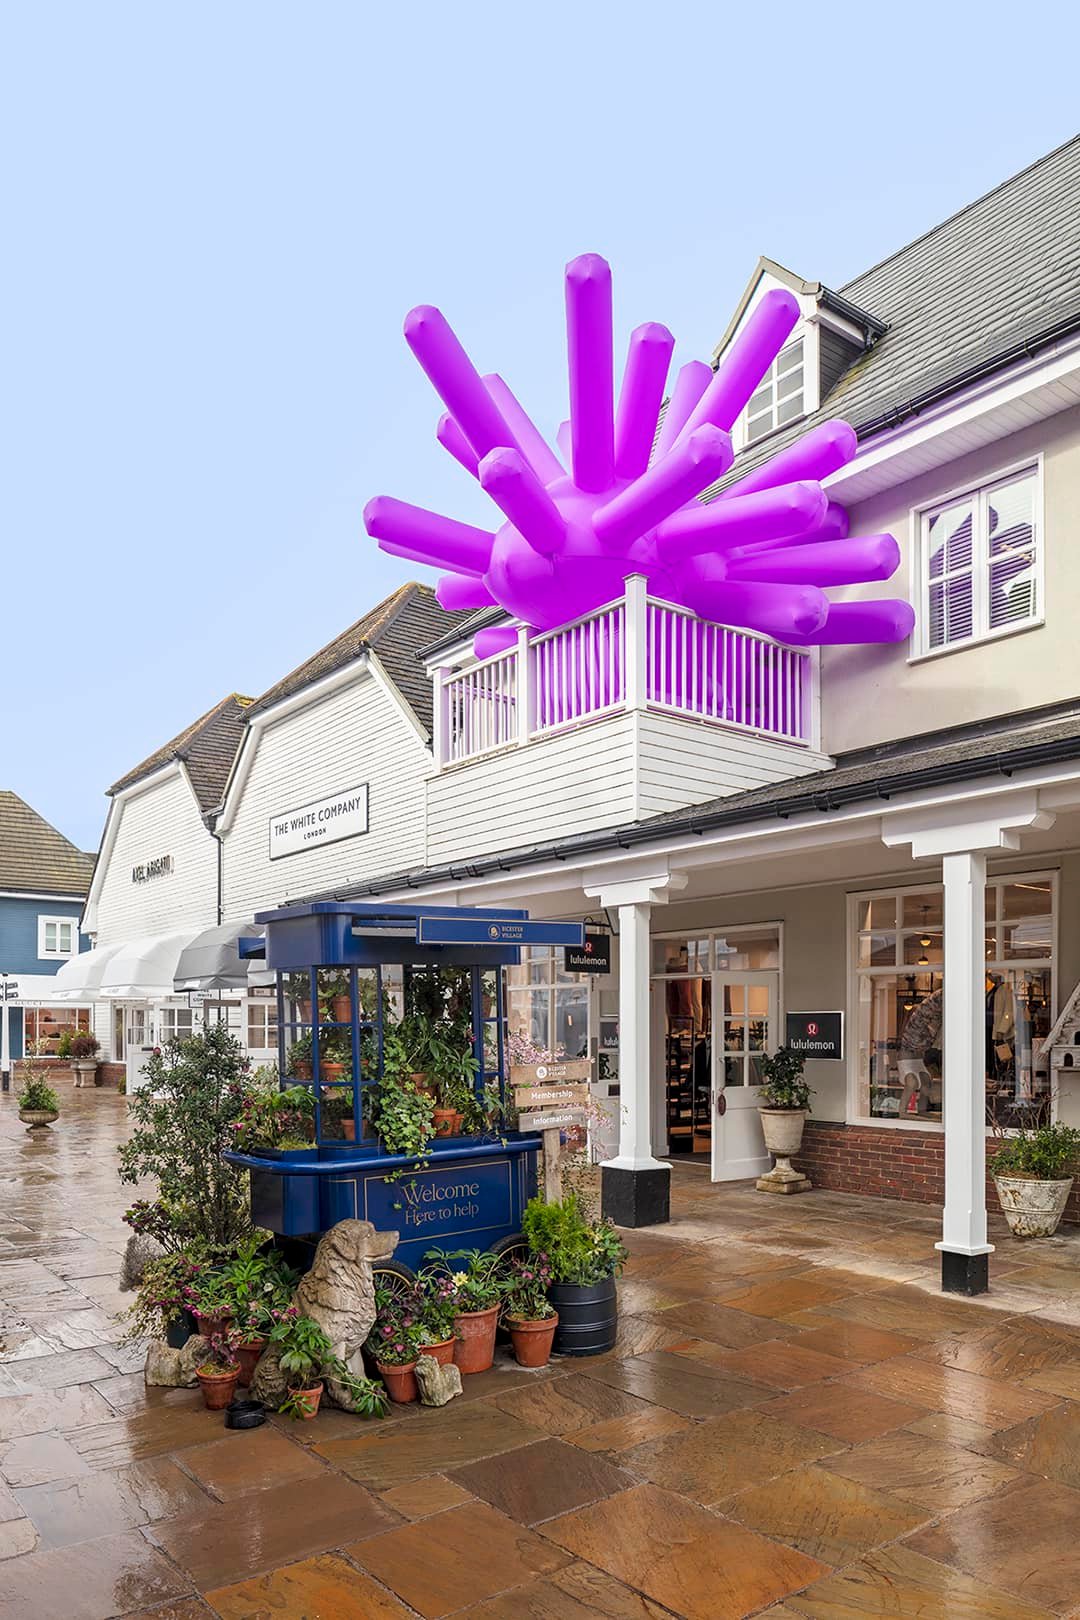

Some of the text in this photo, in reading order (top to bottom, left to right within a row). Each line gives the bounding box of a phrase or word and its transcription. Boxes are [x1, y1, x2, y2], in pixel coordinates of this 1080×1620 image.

[274, 797, 360, 836] THE WHITE COMPANY
[303, 827, 327, 840] LONDON
[570, 955, 607, 965] lululemon
[790, 1039, 835, 1050] lululemon
[531, 1090, 573, 1100] Membership
[533, 1114, 573, 1125] Information
[401, 1183, 480, 1203] Welcome
[405, 1201, 480, 1225] Here to help
